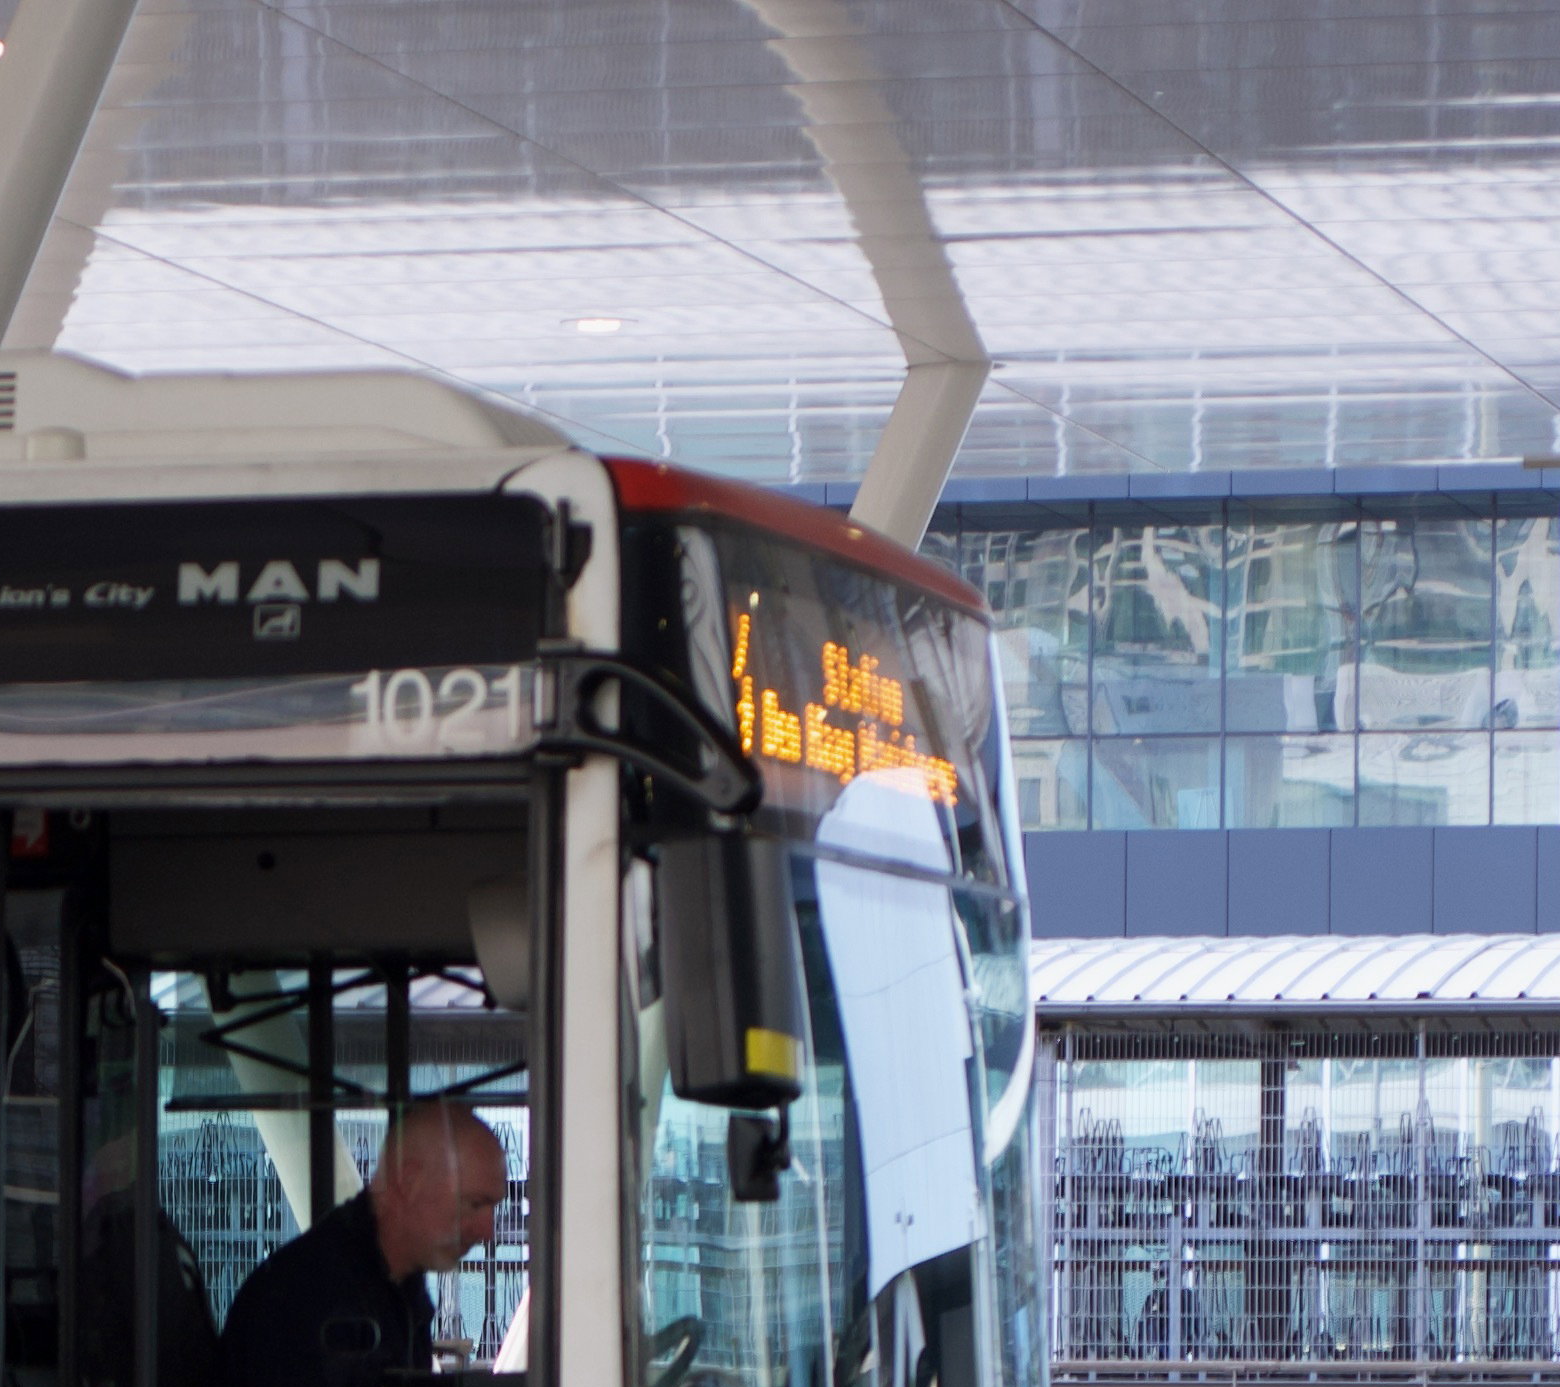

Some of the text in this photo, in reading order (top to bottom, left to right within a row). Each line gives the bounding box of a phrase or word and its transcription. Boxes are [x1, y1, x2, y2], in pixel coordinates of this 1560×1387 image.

[83, 581, 155, 609] City
[177, 558, 380, 604] MAN
[349, 666, 522, 745] 1021
